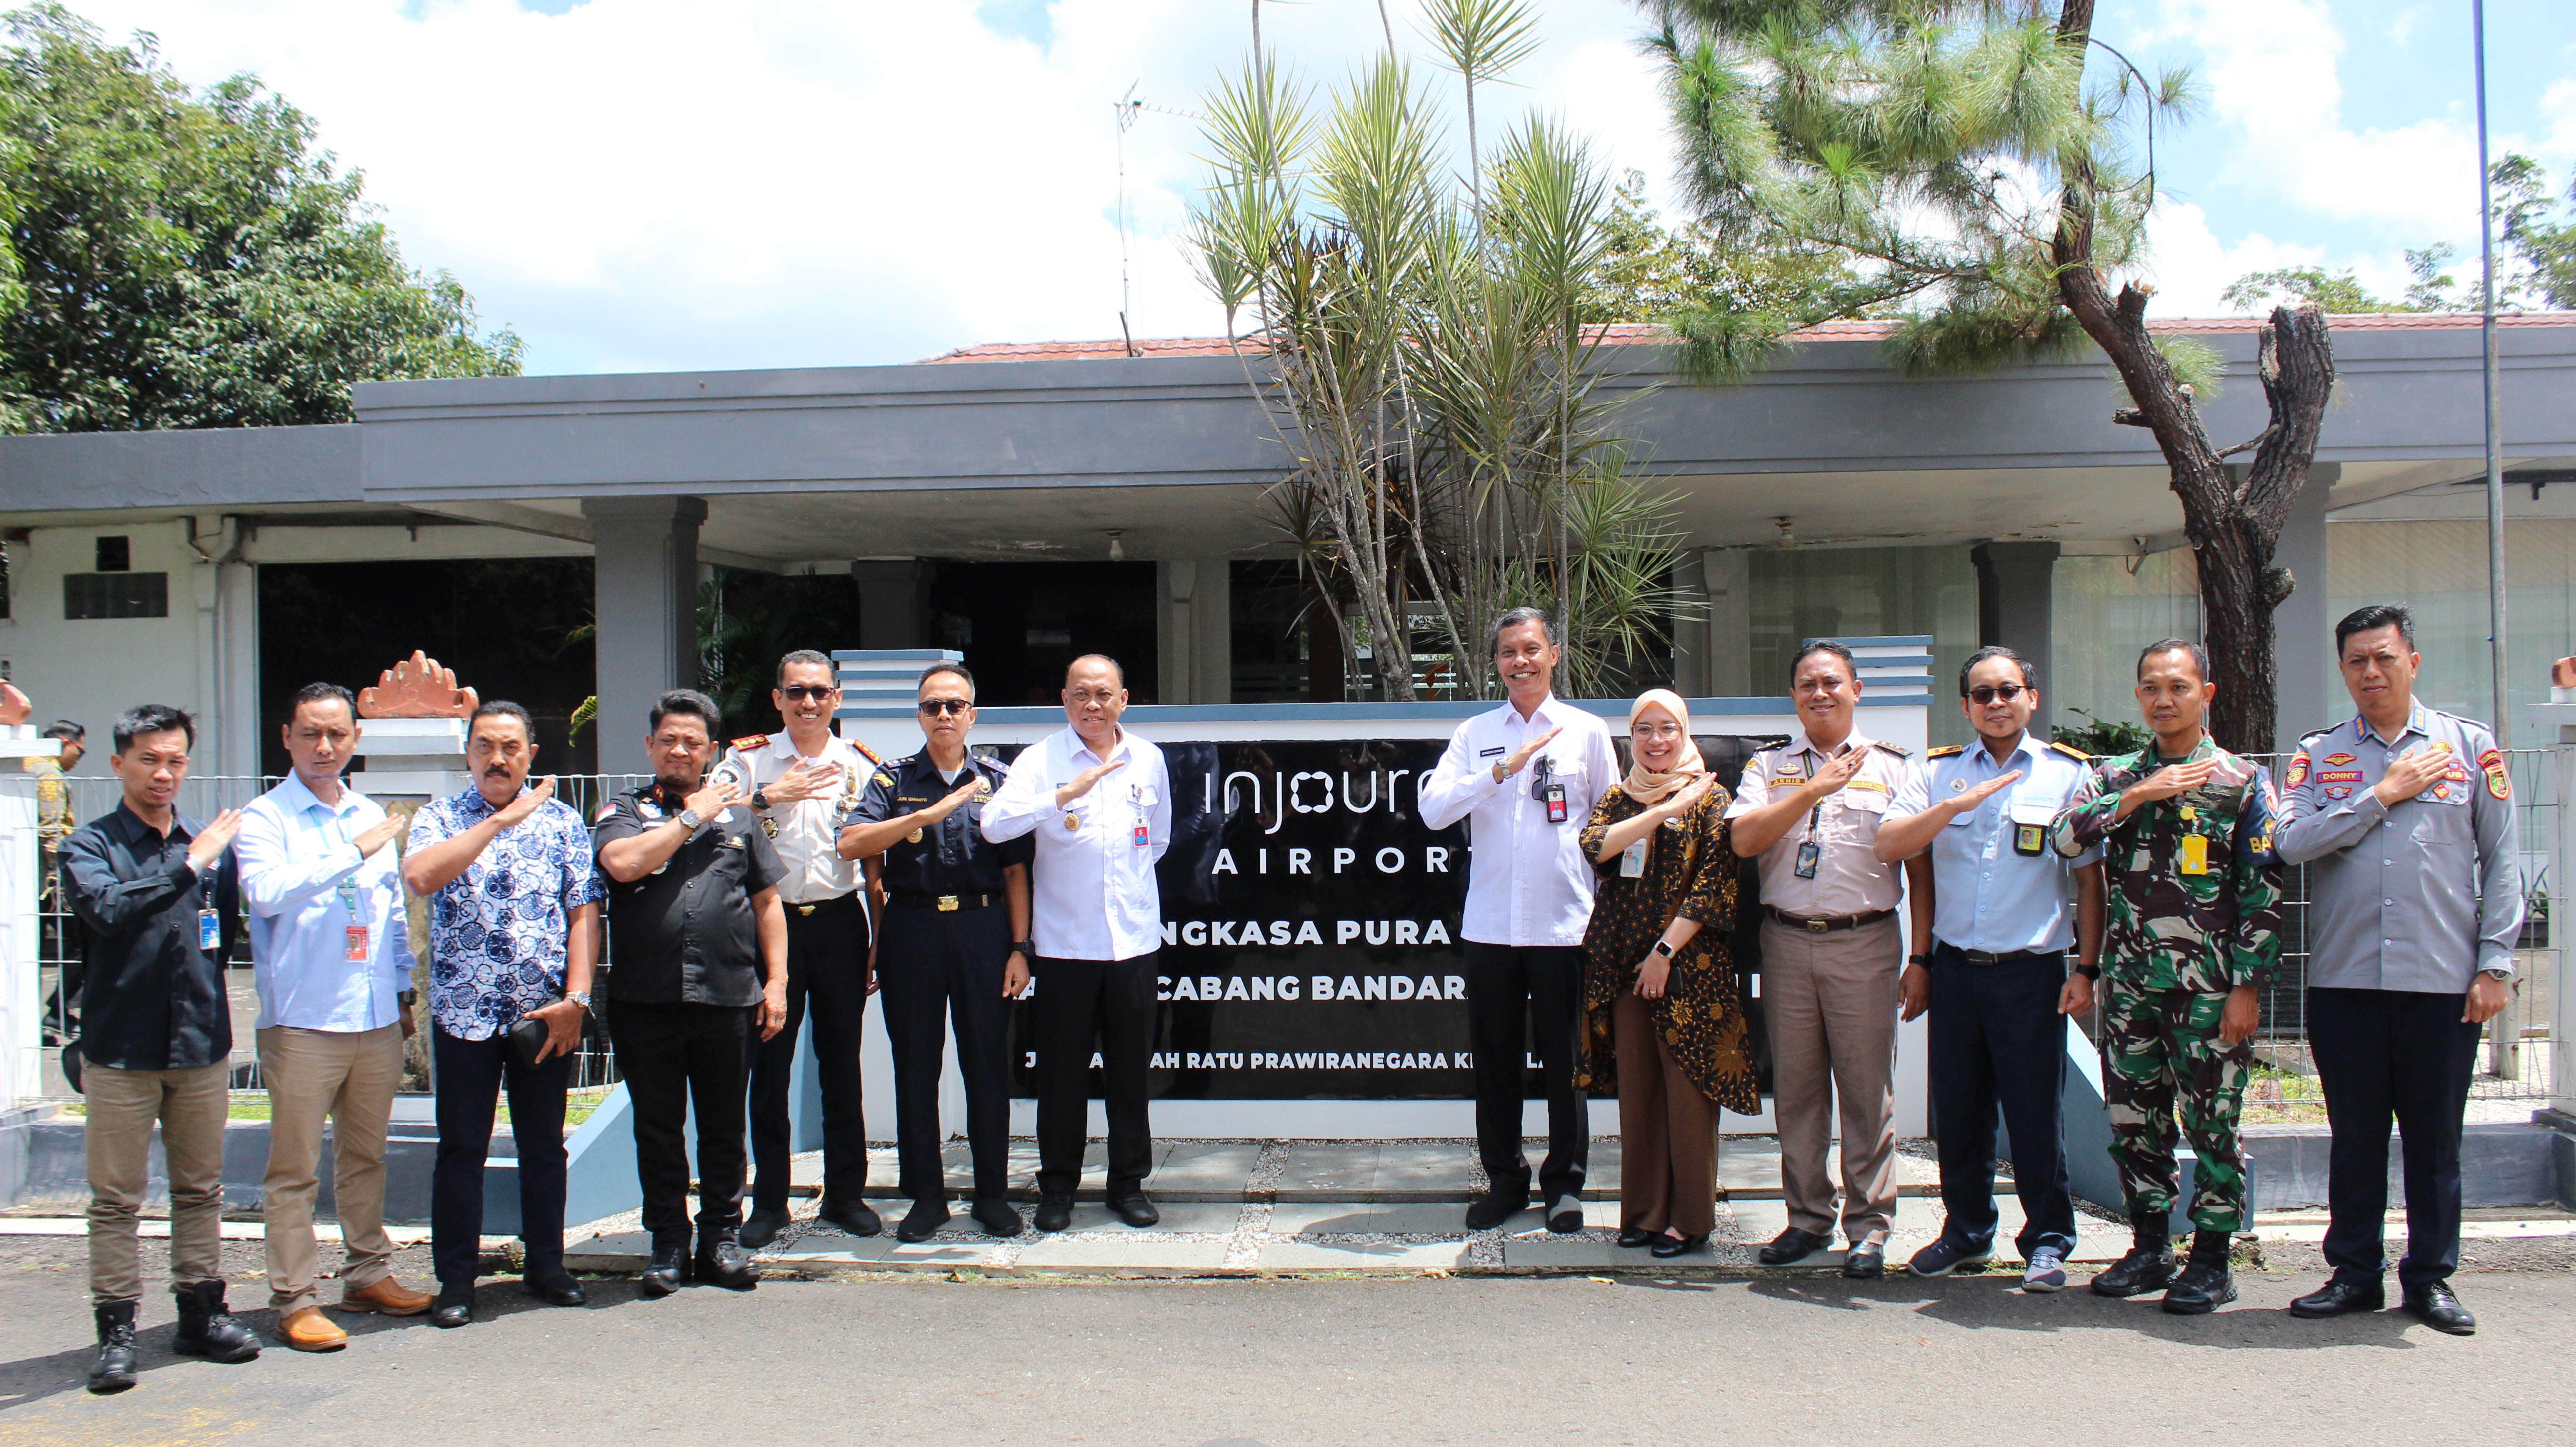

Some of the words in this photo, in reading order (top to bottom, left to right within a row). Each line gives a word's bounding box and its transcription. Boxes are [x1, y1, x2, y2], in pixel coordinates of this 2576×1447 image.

[1850, 781, 1885, 791] QUARANTINE
[1211, 846, 1472, 874] AIRPOR
[1161, 921, 1323, 945] NGKASA
[1337, 920, 1451, 945] PURA
[1157, 976, 1300, 1001] CABANG
[1312, 976, 1469, 1001] BANDAR
[1187, 1053, 1244, 1069] RATU
[1250, 1053, 1449, 1069] PRAWIRANEGARA
